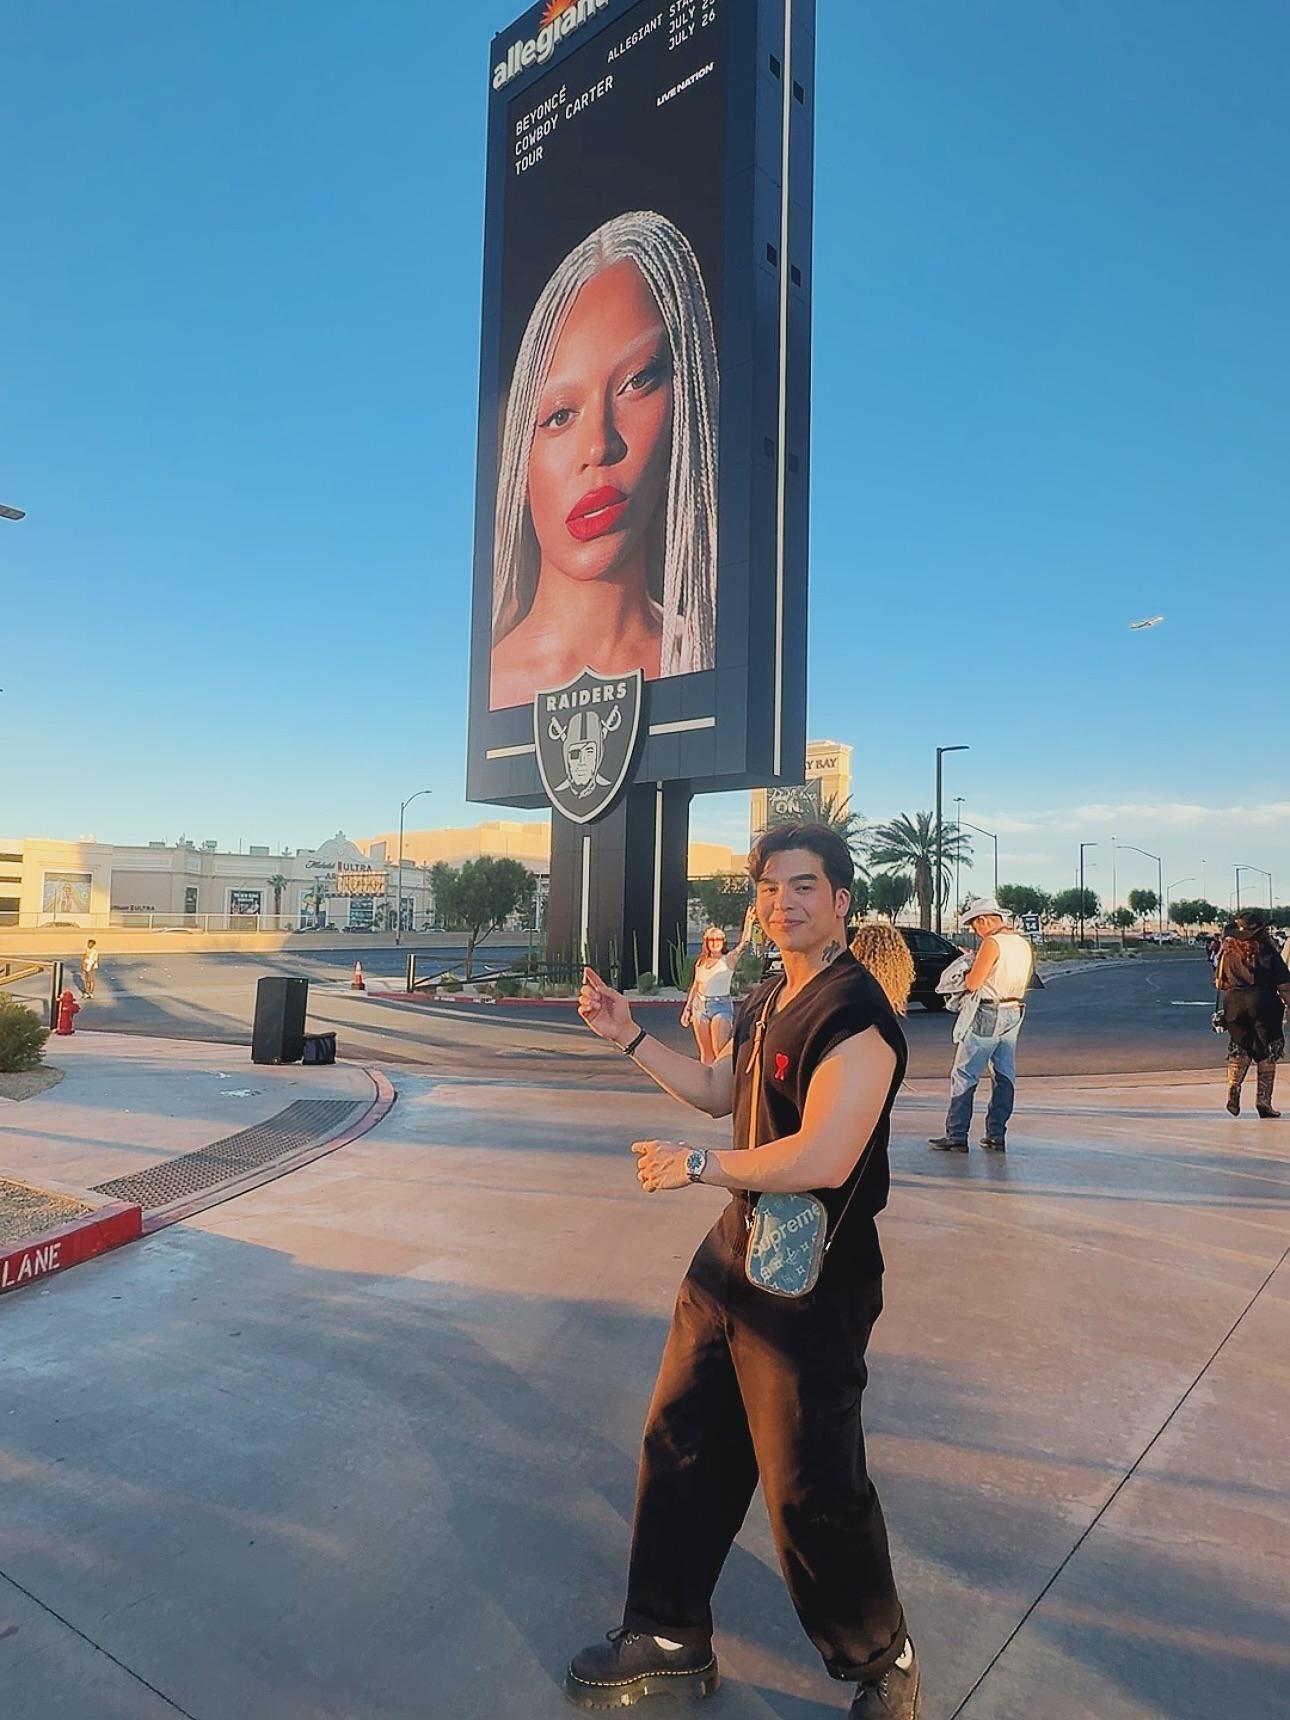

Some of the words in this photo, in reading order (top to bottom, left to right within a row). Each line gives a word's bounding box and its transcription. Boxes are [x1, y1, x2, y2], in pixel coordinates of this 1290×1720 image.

[607, 13, 663, 63] ALLEGIANT
[668, 5, 695, 34] JULY
[668, 22, 695, 51] JULY
[701, 8, 716, 27] 26
[656, 87, 677, 107] LIVE
[676, 61, 715, 93] NATION
[515, 84, 567, 136] BEYONCÉ
[515, 114, 559, 156] COWBOY
[565, 75, 614, 120] CARTER
[514, 145, 543, 176] TOUR
[546, 682, 627, 712] RAIDERS
[816, 757, 837, 770] BAY
[343, 862, 372, 873] ULTRA
[1, 1242, 61, 1288] LANE
